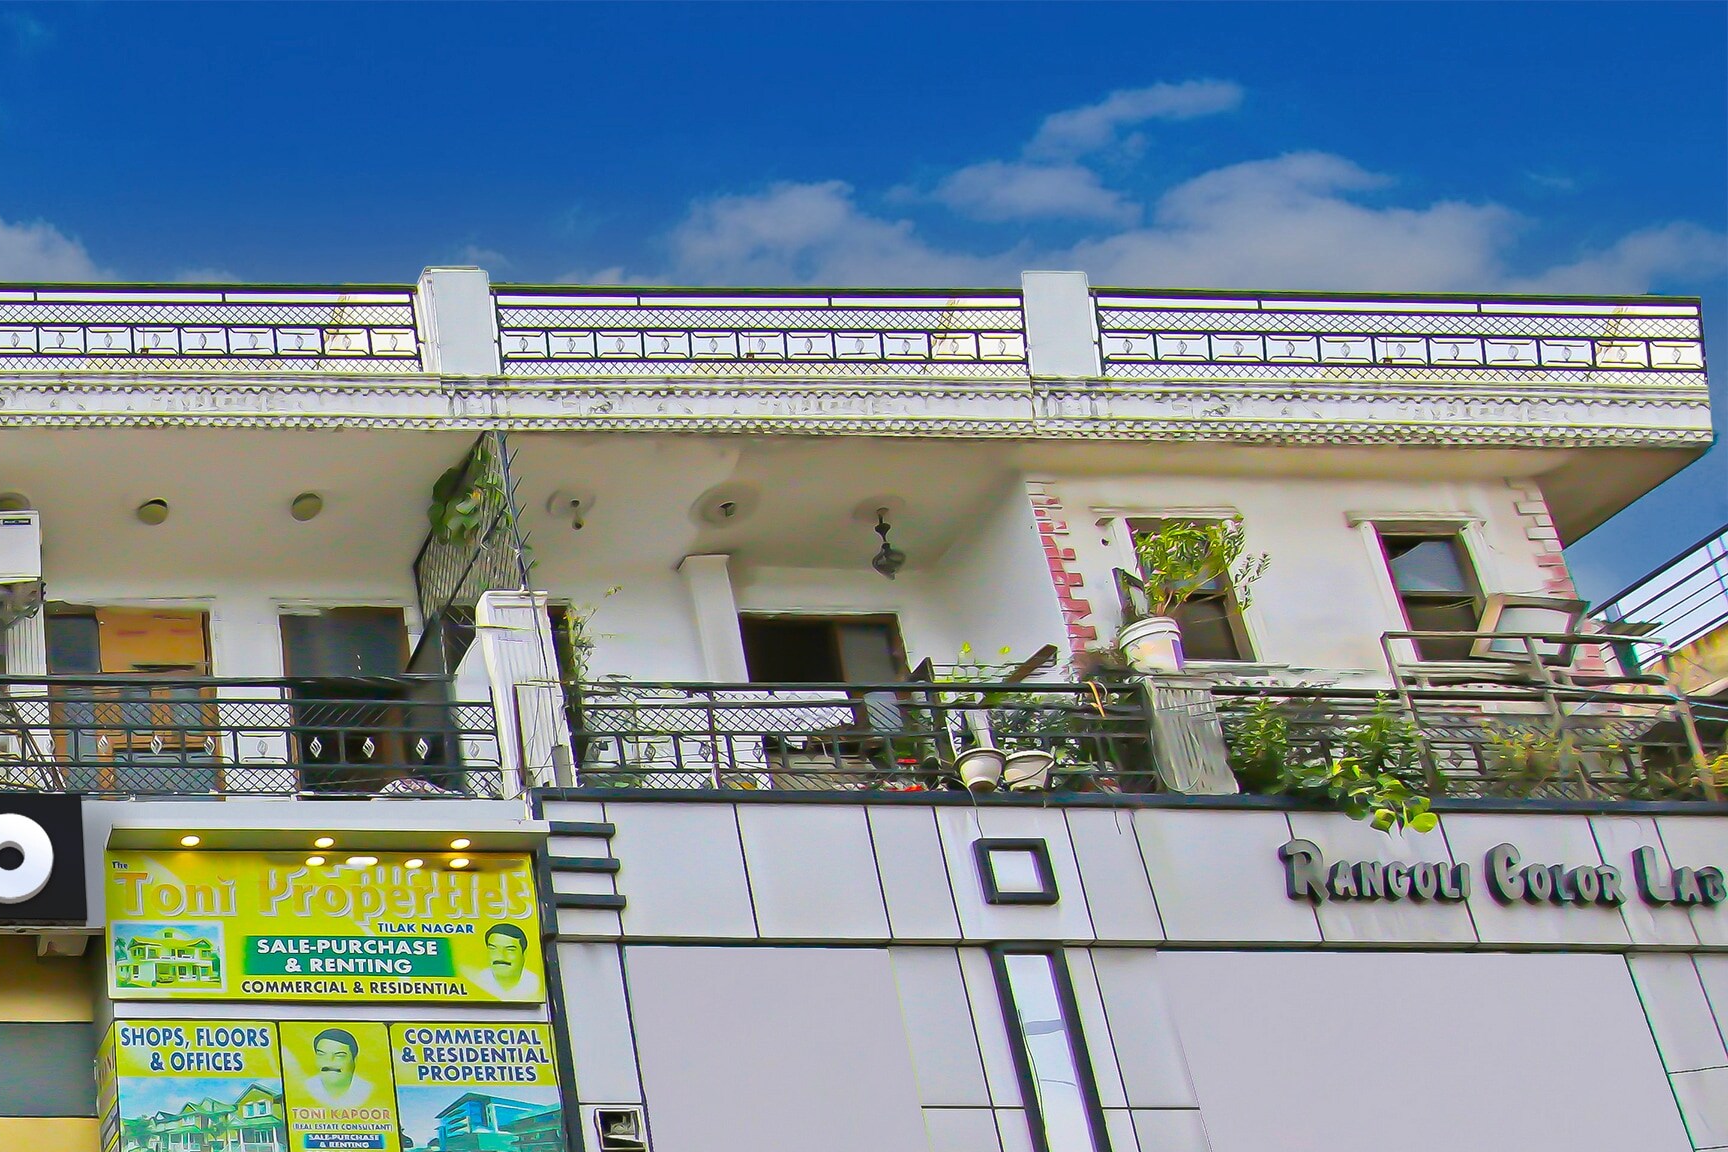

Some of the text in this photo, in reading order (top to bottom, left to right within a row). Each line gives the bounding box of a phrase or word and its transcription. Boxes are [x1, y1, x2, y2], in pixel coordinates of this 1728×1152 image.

[112, 861, 128, 869] The
[113, 864, 534, 926] Toni Properties
[378, 923, 475, 935] TILAK NAGAR
[257, 939, 438, 956] SALE-PURCHASE
[285, 958, 413, 974] & RENTING
[241, 980, 468, 996] COMMERCIAL & RESIDENTIAL
[121, 1027, 270, 1048] SHOPS, FLOORS
[404, 1028, 542, 1045] COMMERCIAL
[150, 1052, 244, 1071] & OFFICES
[401, 1046, 550, 1063] & RESIDENTIAL
[418, 1065, 537, 1082] PROPERTIES
[292, 1108, 391, 1120] TONI KAPOOR
